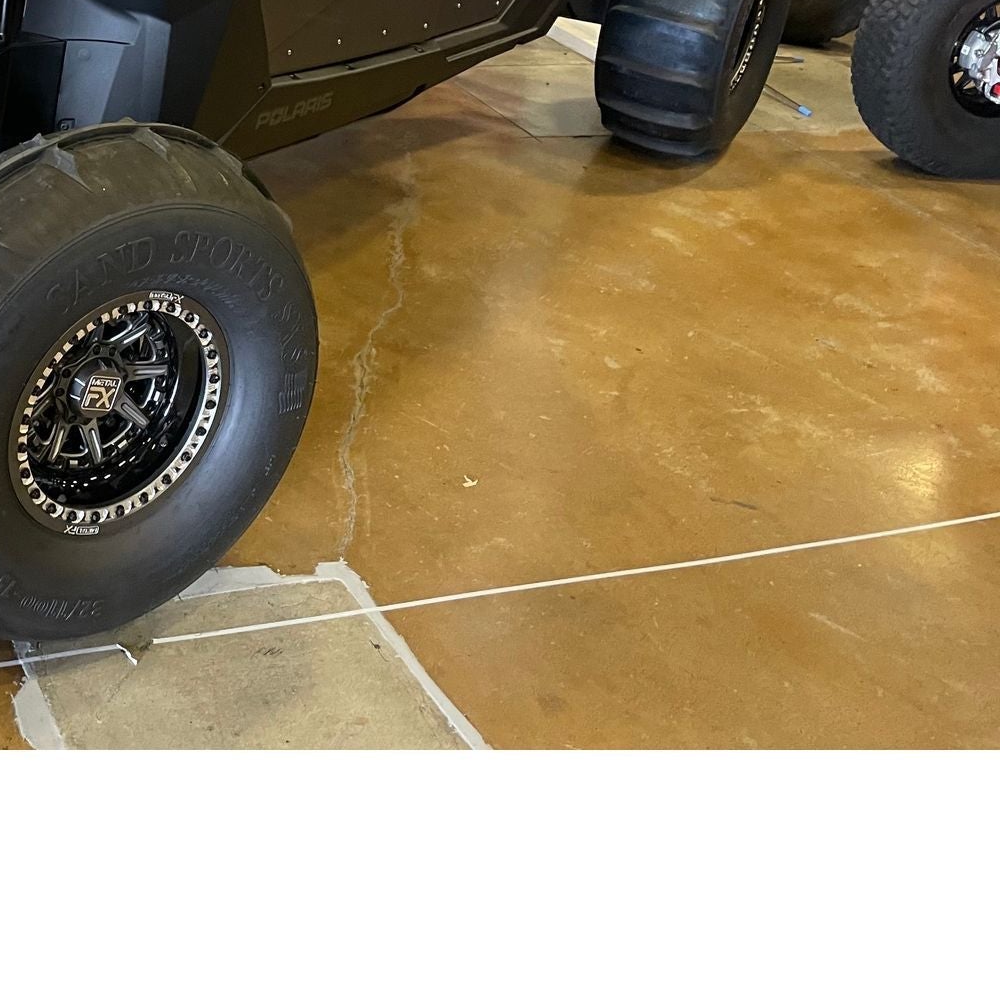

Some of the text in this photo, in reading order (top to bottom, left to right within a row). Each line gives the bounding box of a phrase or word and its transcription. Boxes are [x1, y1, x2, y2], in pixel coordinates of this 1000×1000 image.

[256, 92, 334, 130] POLARIS
[92, 379, 117, 387] METAL
[84, 386, 115, 408] FX
